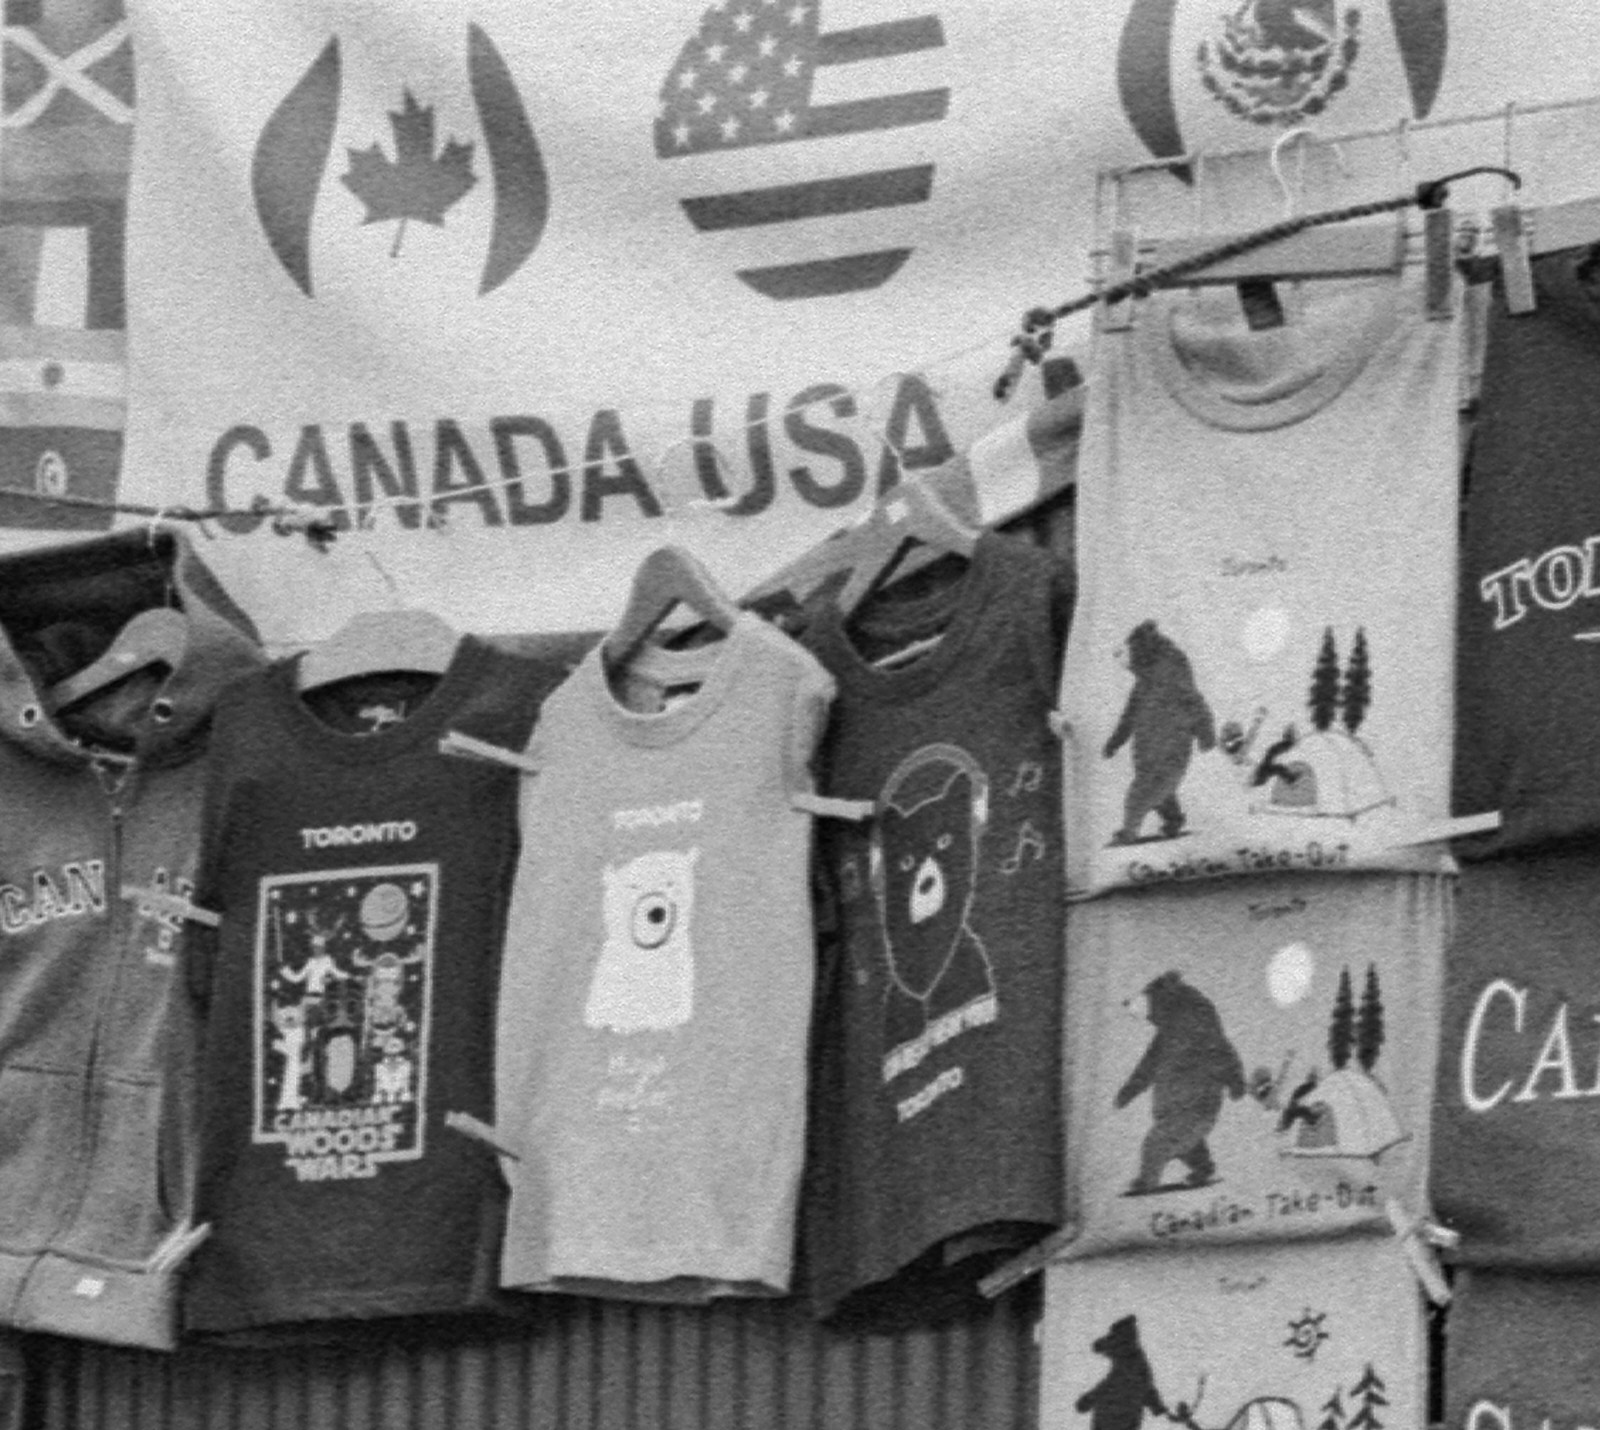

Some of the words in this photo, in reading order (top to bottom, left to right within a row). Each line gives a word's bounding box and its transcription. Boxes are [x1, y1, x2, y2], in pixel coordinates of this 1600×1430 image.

[206, 405, 662, 532] CANADA
[688, 373, 956, 517] USA
[301, 821, 417, 849] TORONTO
[1151, 1195, 1254, 1238] Canadian
